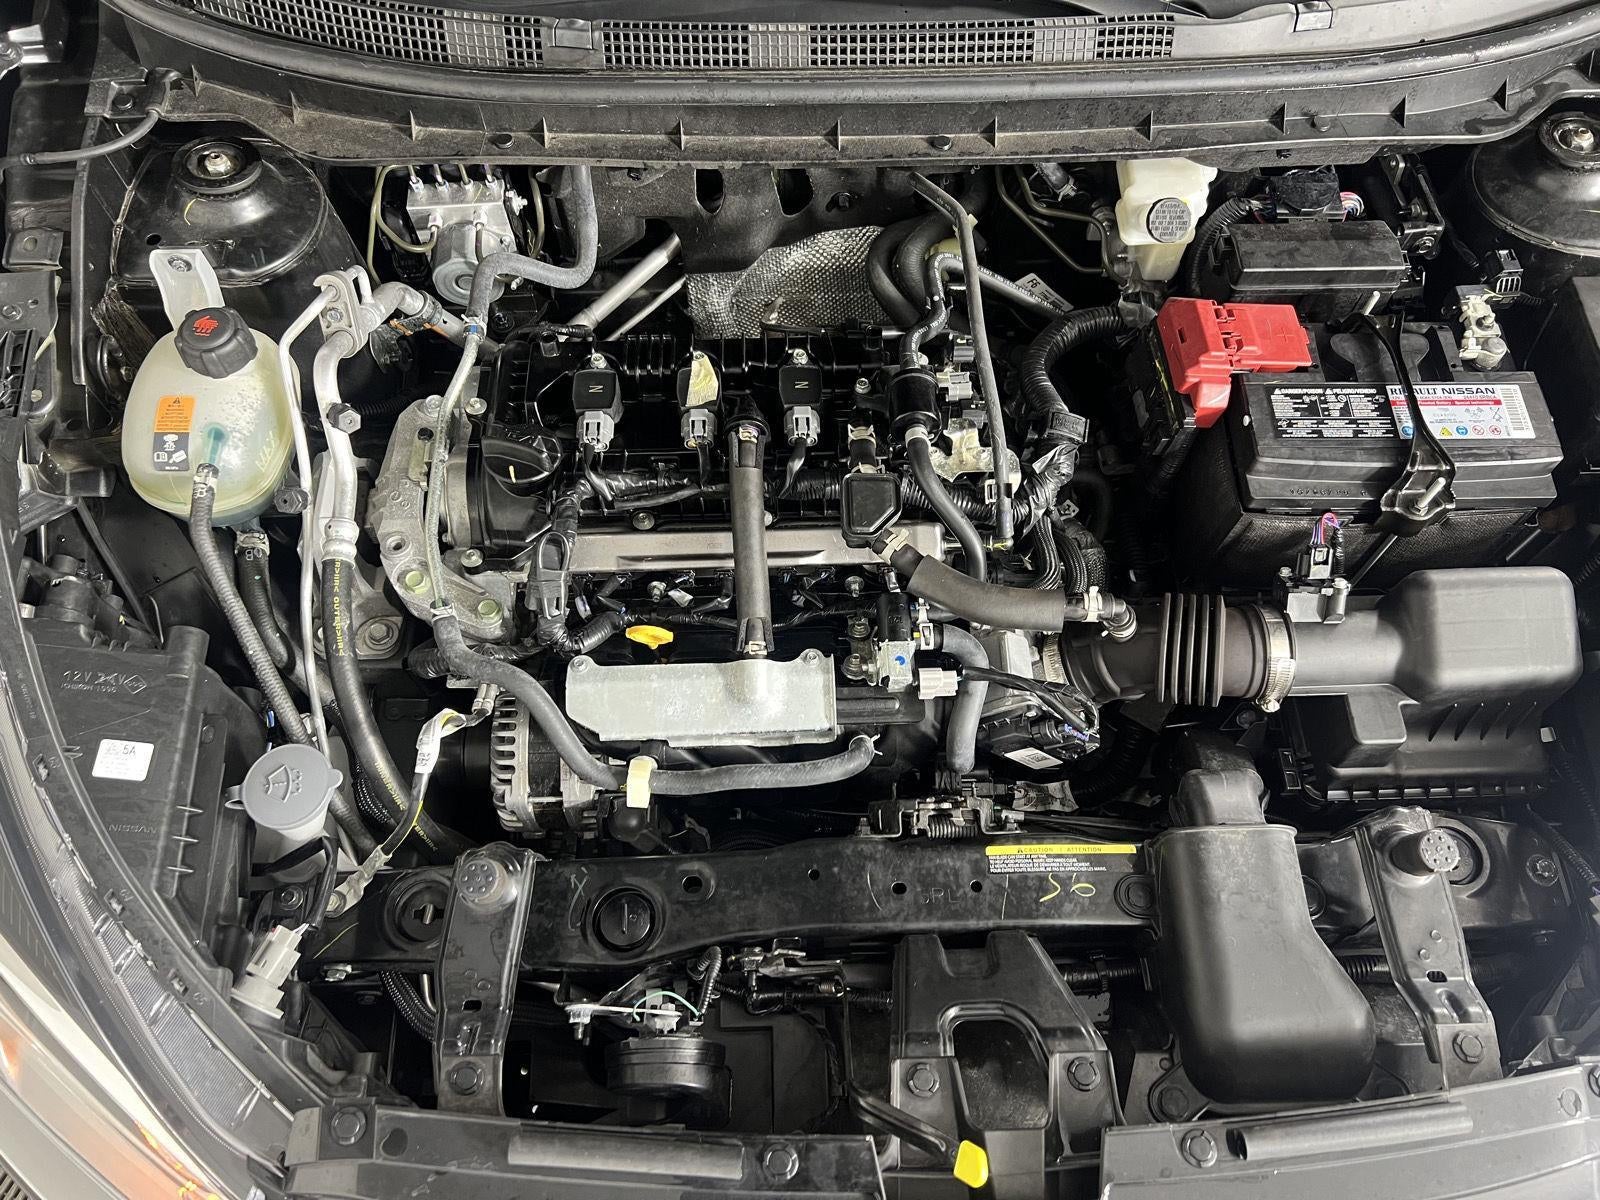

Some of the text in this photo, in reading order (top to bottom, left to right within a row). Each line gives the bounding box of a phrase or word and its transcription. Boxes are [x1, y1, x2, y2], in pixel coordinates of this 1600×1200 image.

[1389, 387, 1496, 396] RAULT NISSAN
[108, 823, 157, 834] NISSAN
